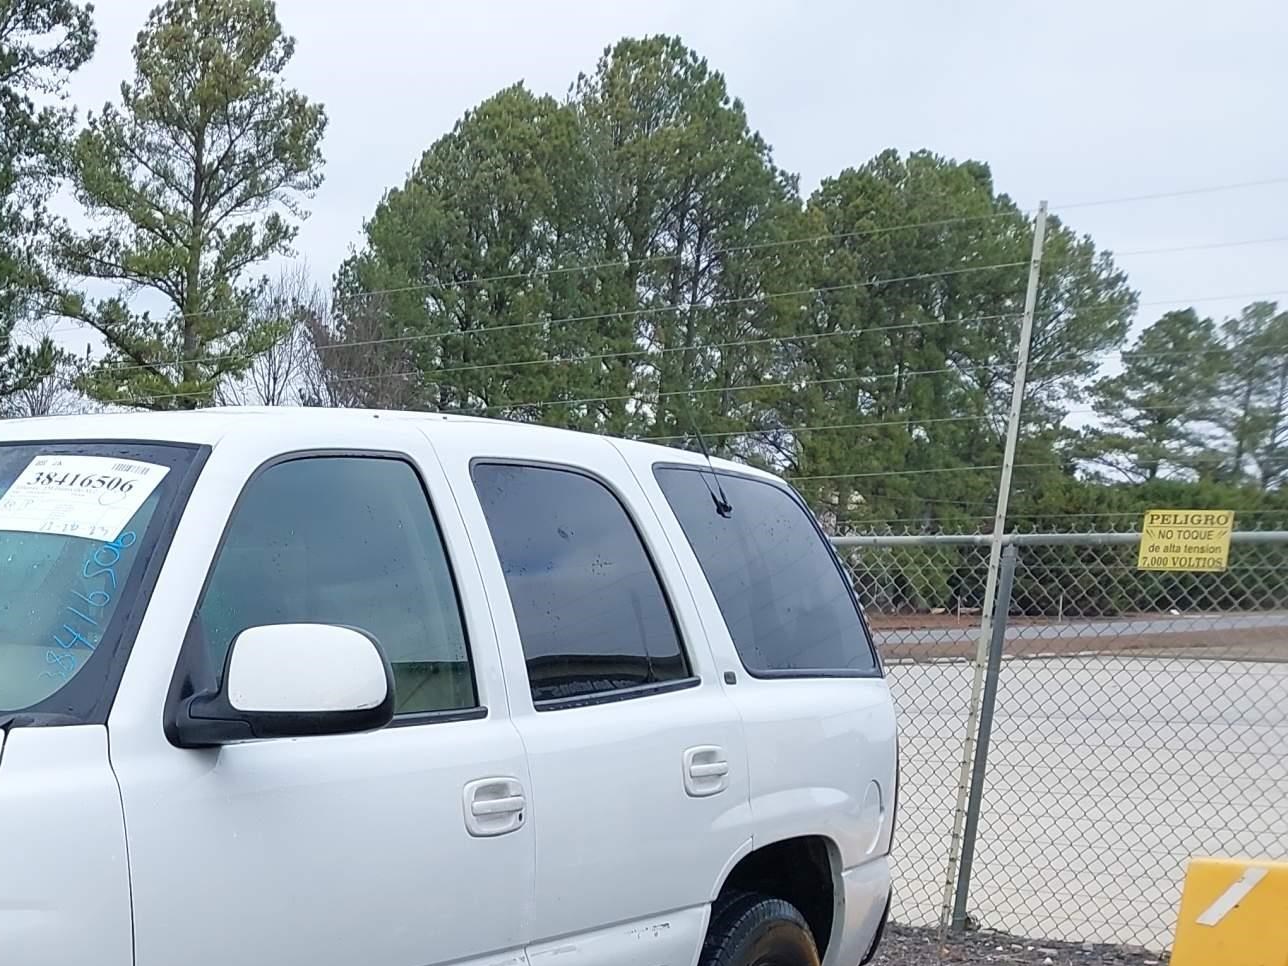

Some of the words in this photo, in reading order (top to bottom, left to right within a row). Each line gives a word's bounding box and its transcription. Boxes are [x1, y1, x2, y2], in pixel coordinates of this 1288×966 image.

[26, 471, 138, 493] 38416506
[1149, 513, 1229, 526] PELIGRO
[1157, 529, 1174, 540] NO
[1177, 529, 1214, 540] TOQUE
[1148, 543, 1160, 553] de
[1162, 543, 1181, 553] alta
[1183, 544, 1221, 554] tension
[1171, 556, 1224, 568] VOLTIOS
